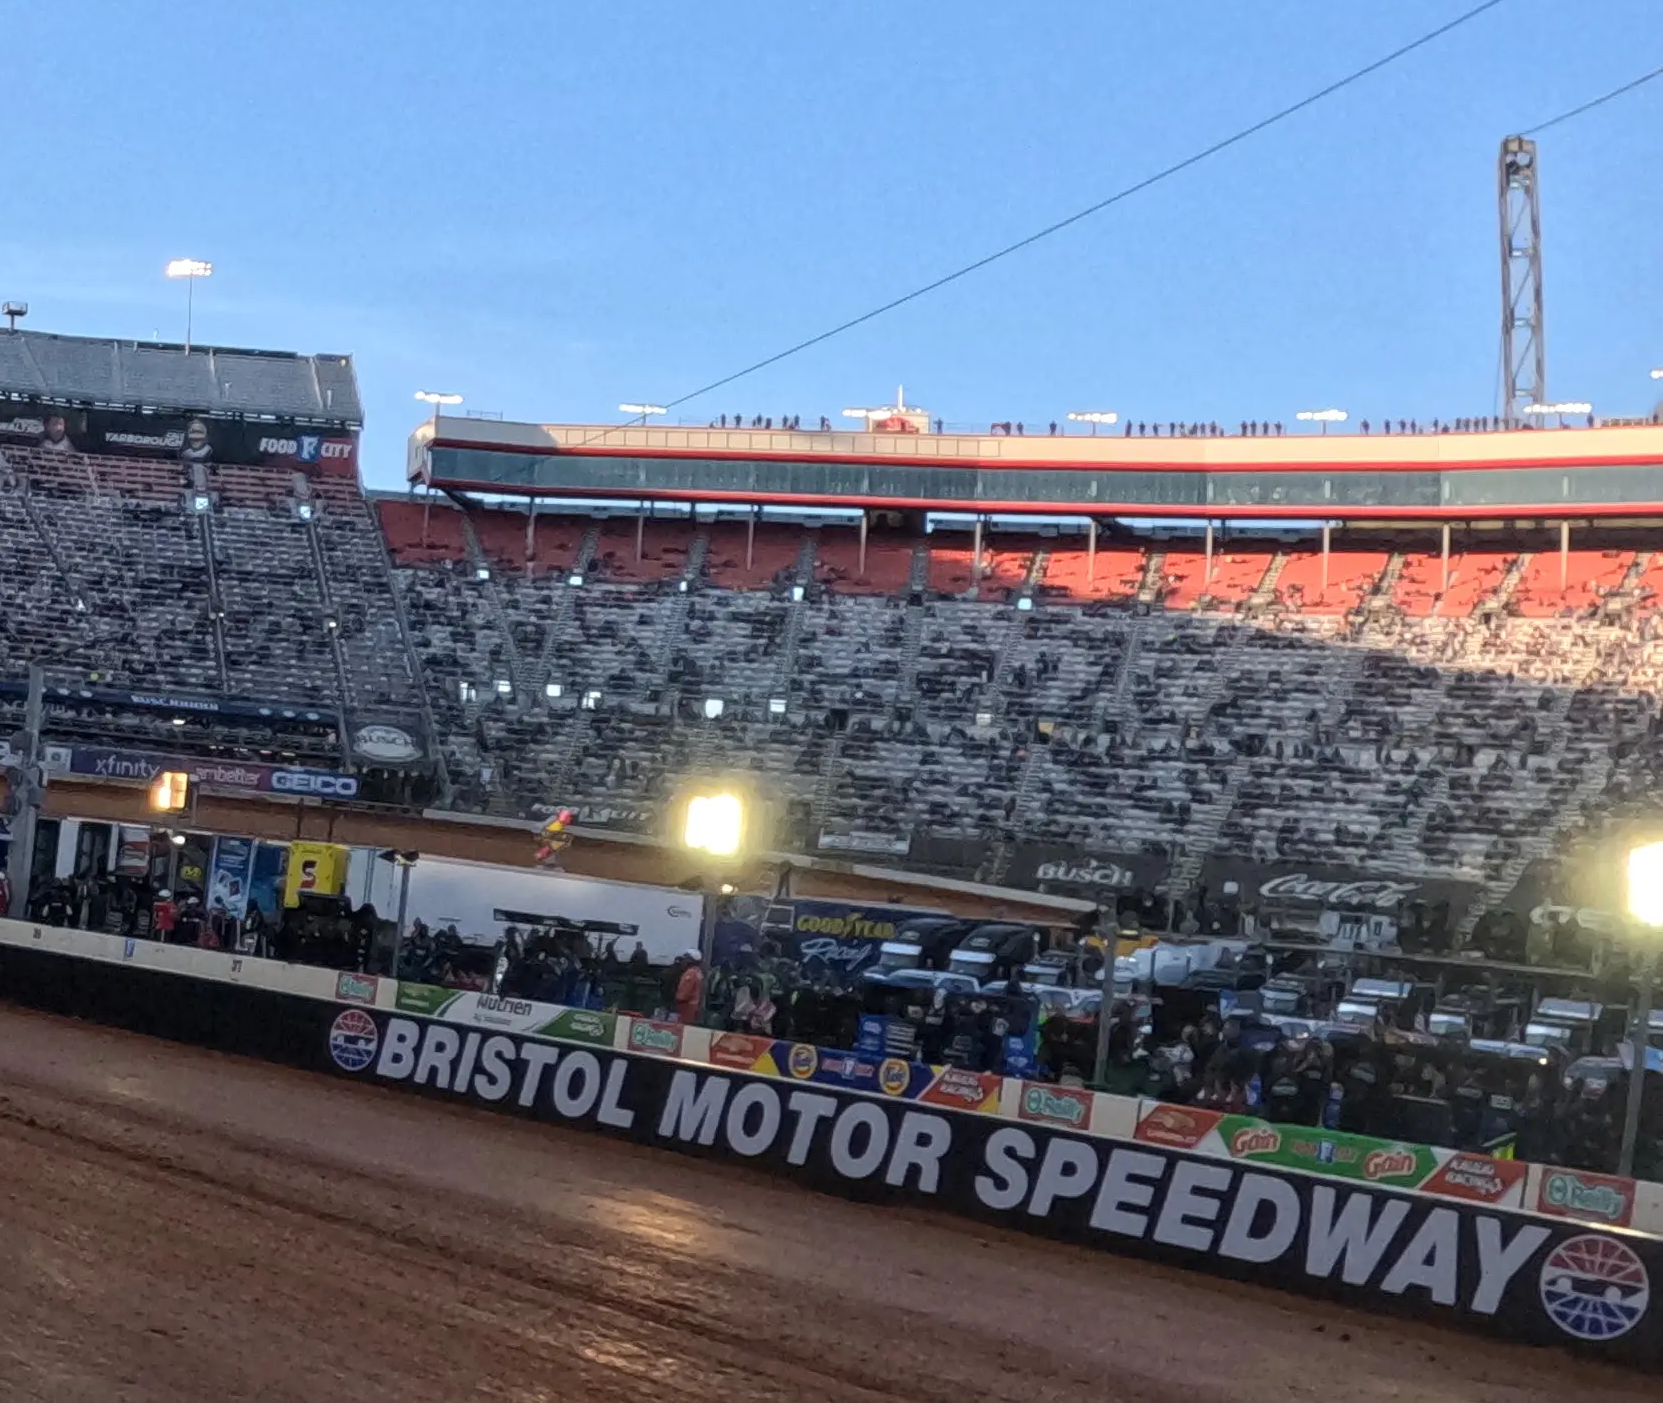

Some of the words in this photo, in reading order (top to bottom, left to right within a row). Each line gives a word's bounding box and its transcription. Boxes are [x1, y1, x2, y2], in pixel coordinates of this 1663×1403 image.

[259, 437, 297, 453] FOOD
[320, 442, 353, 459] CITY
[95, 754, 161, 778] xfinity
[271, 770, 358, 795] GEICO
[796, 912, 898, 939] GOODYEAR
[1233, 1127, 1281, 1154] Gain
[376, 1018, 638, 1130] BRISTOL
[658, 1070, 953, 1194] MOTOR
[975, 1127, 1552, 1316] SPEEDWAY
[1363, 1148, 1416, 1180] Gain
